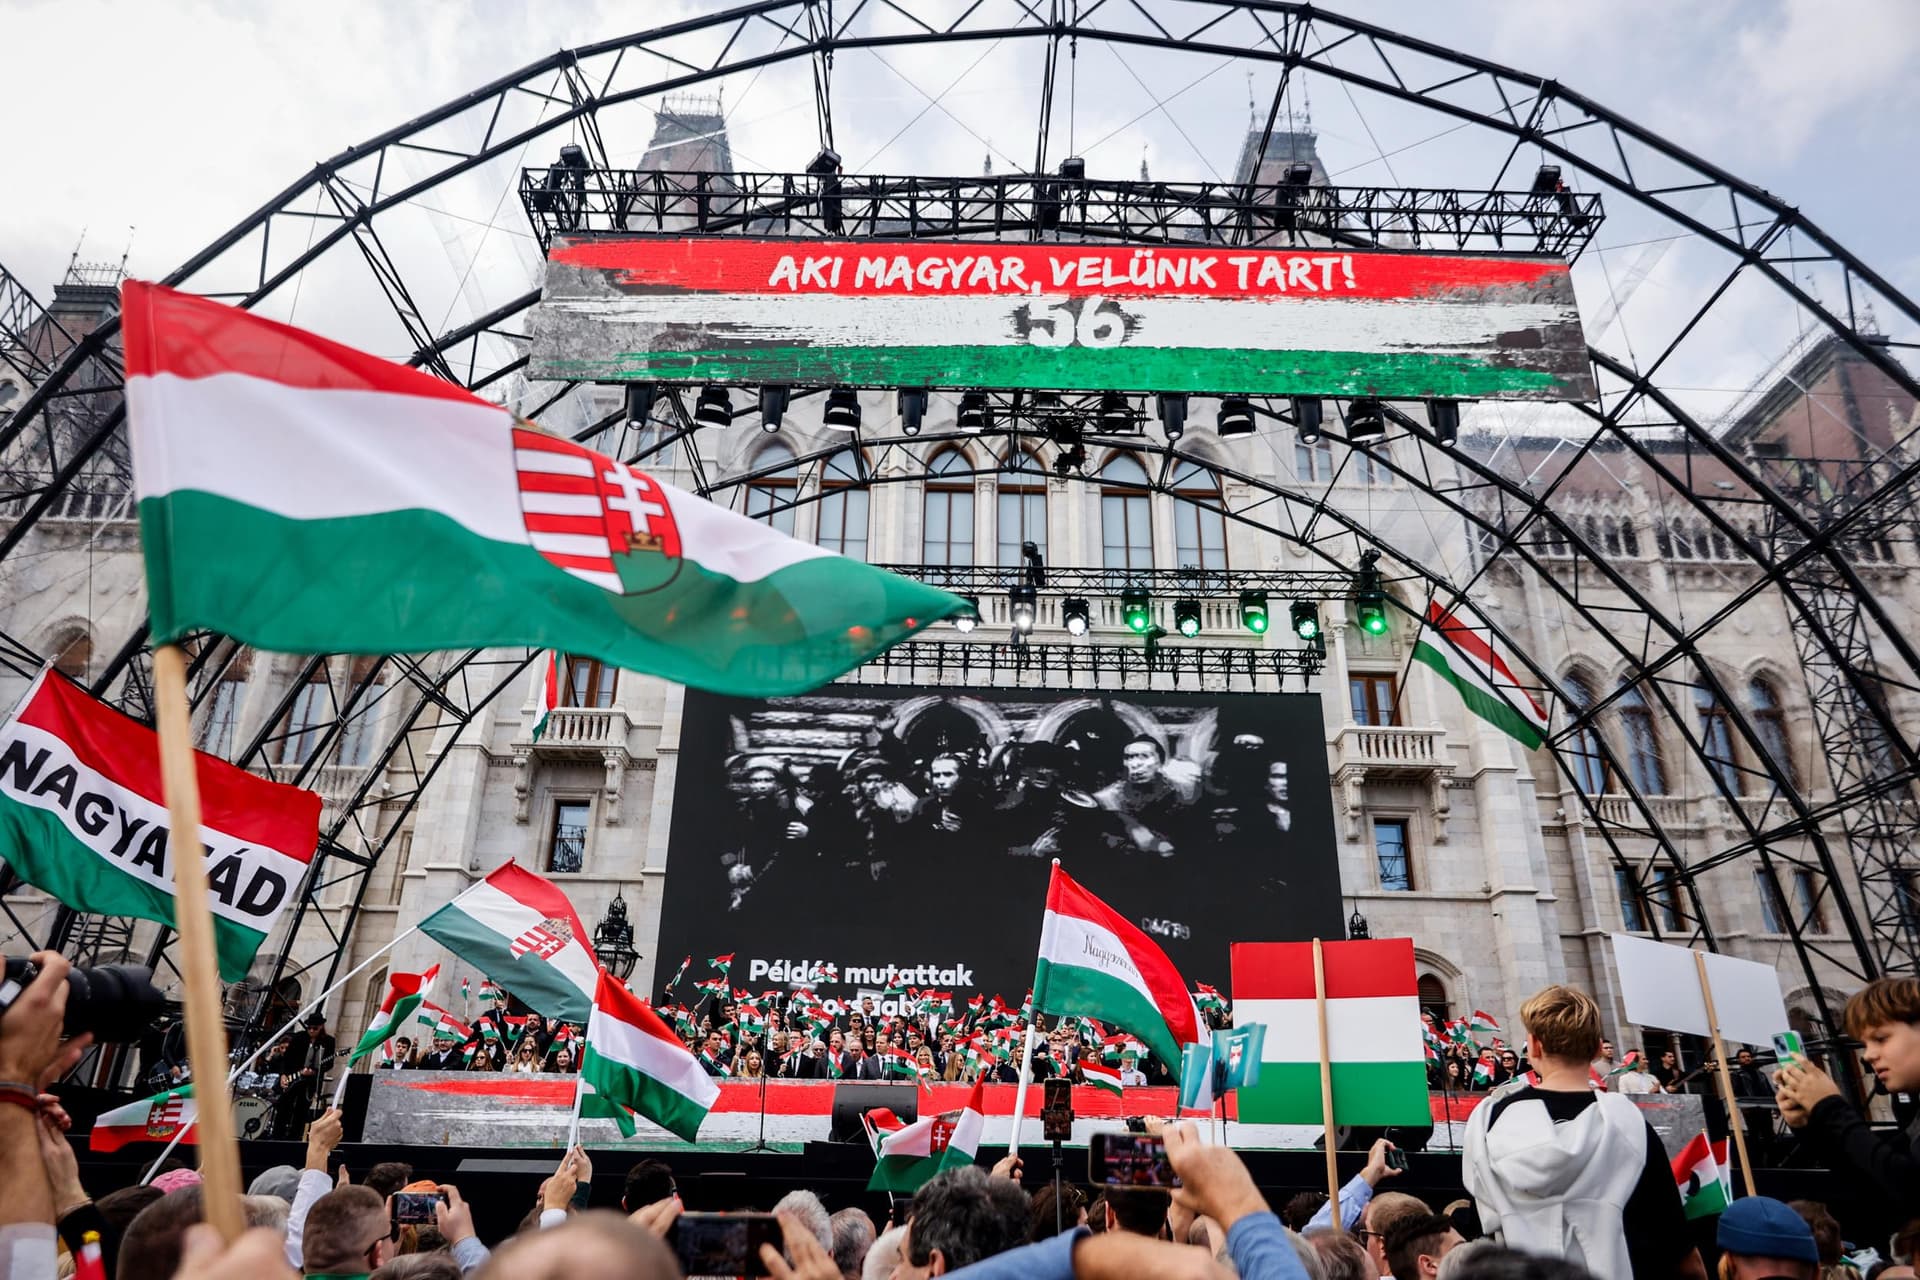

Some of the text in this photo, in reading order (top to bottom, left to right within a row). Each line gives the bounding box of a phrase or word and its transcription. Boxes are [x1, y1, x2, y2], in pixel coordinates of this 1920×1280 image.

[768, 249, 1357, 297] AKI MAGYAR, VELÜNK TART!
[1028, 293, 1126, 348] 56
[0, 739, 287, 917] NAGYAÁD
[749, 959, 974, 986] Példát mutattak
